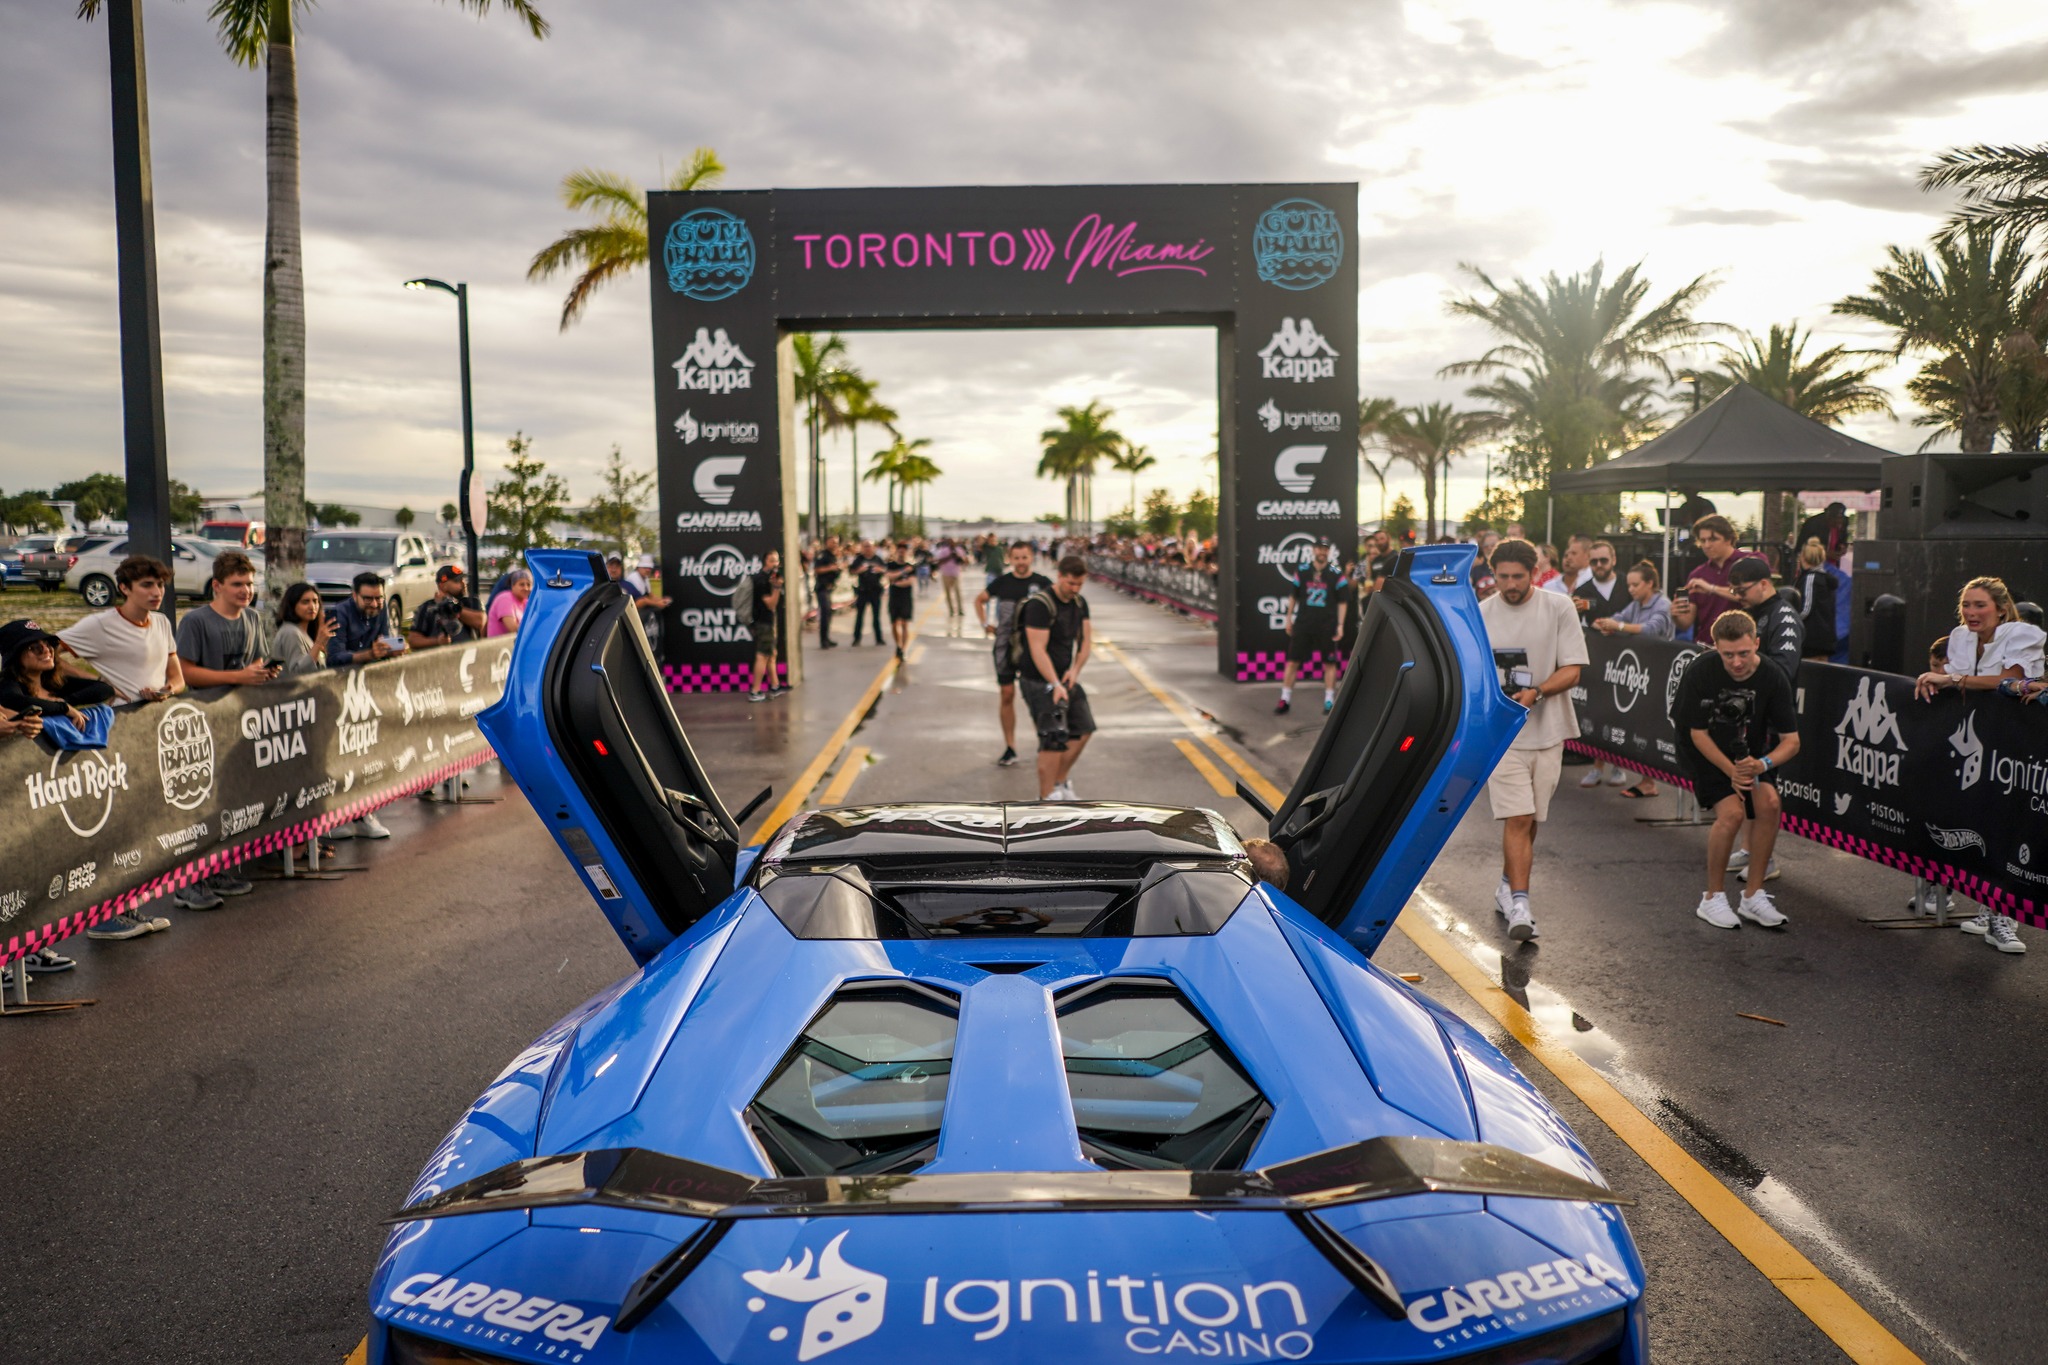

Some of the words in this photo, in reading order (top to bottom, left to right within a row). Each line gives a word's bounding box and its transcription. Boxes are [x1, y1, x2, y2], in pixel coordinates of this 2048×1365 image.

[793, 231, 1017, 270] TORONTO
[1064, 213, 1215, 285] Miami
[677, 365, 752, 395] Kappa
[1262, 356, 1336, 383] Kappa
[677, 510, 762, 528] CARRERA
[1256, 499, 1341, 516] CARRERA
[680, 555, 722, 577] Hard
[722, 554, 763, 580] Rock
[1257, 544, 1300, 565] Hard
[1306, 588, 1328, 607] 22
[680, 608, 737, 628] QNT
[693, 625, 753, 643] DNA
[1604, 660, 1628, 687] Hard
[1626, 664, 1650, 696] Rock
[158, 711, 210, 749] GUM
[241, 697, 316, 741] QNTM
[254, 730, 307, 769] DNA
[338, 718, 379, 757] Kappa
[161, 738, 211, 774] BALL
[1835, 733, 1901, 790] Kappa
[1989, 749, 2048, 795] Igniti
[25, 762, 83, 810] Hard
[80, 751, 129, 800] Rock
[1870, 801, 1905, 824] PISTON
[112, 848, 142, 869] Asprey
[2006, 861, 2024, 878] BOBBY
[921, 1269, 1309, 1342] Ignition
[1406, 1252, 1628, 1334] CARRERA
[390, 1272, 612, 1351] CARRERA
[1433, 1311, 1528, 1350] EYEWEAR
[1537, 1293, 1593, 1317] SINCE
[373, 1304, 454, 1329] EYEWEAR
[463, 1323, 524, 1347] SINCE
[534, 1341, 585, 1364] 1956
[1124, 1326, 1315, 1361] CASINO
